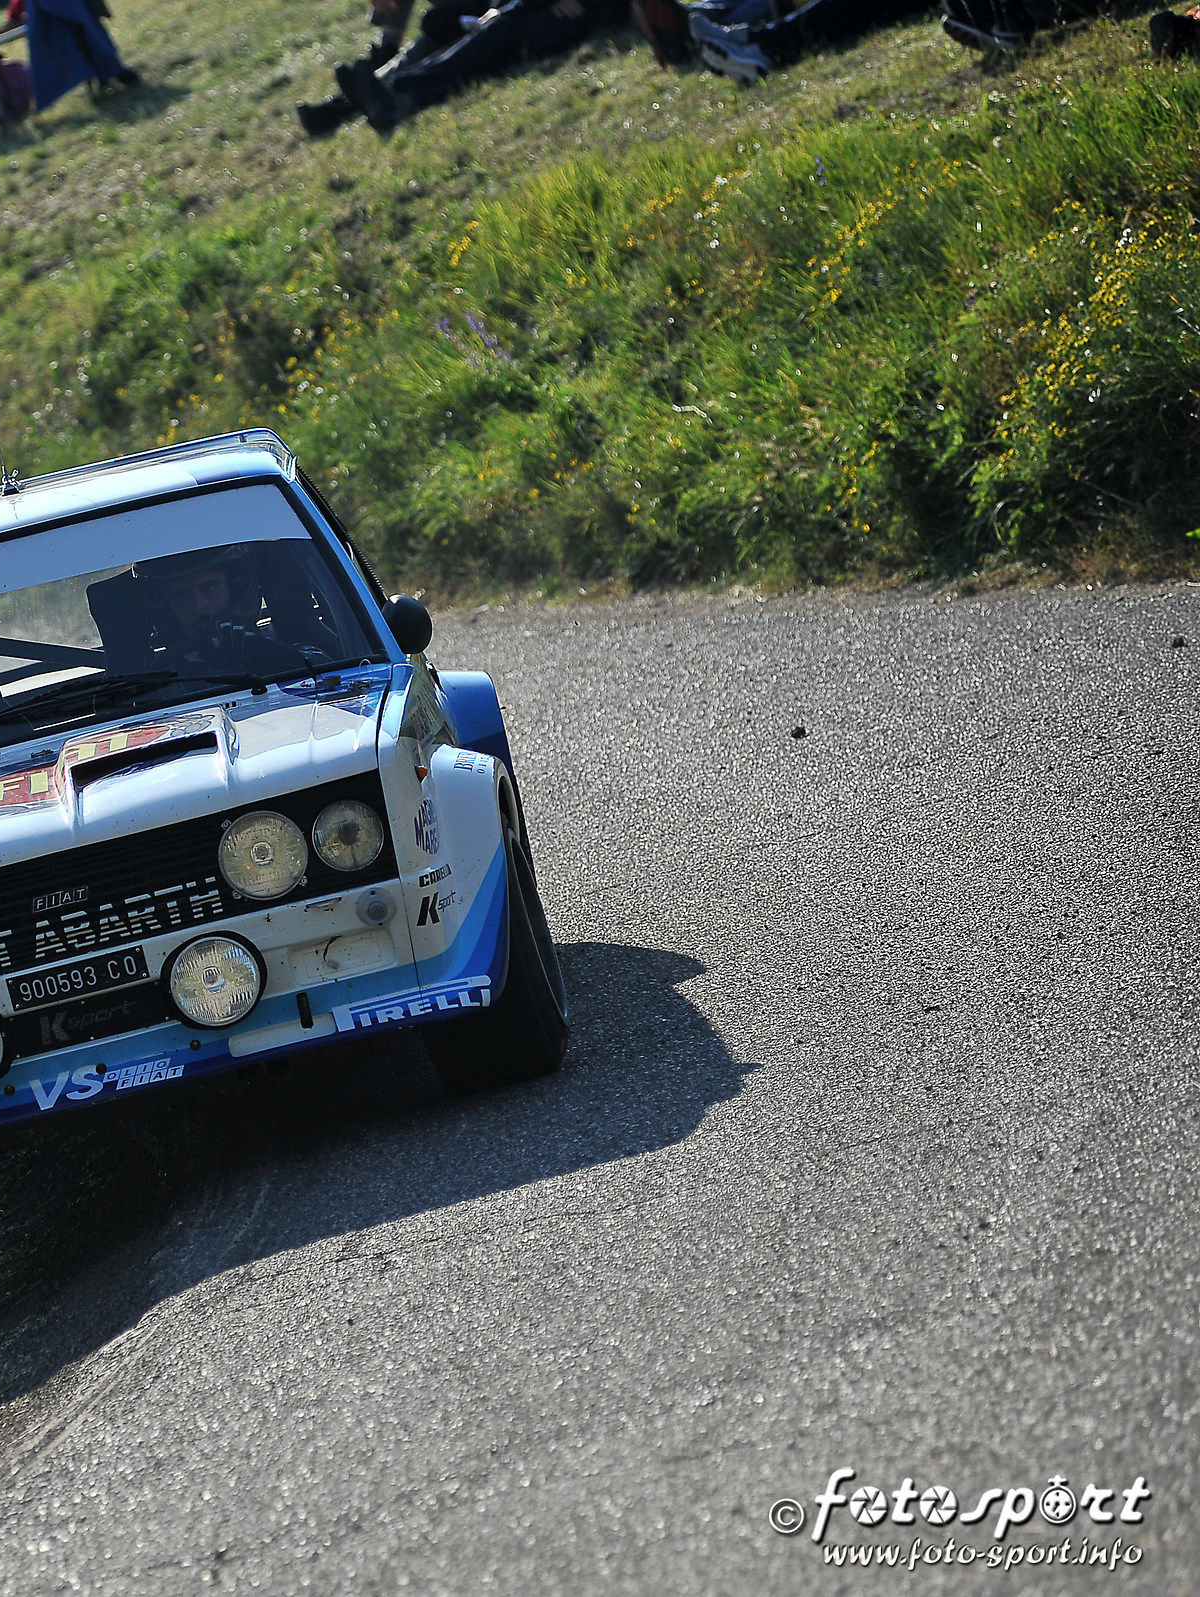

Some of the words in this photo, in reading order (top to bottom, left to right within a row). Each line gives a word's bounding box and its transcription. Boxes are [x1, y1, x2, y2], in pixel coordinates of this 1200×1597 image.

[34, 876, 224, 959] ABARTH
[35, 887, 86, 910] FIAT
[19, 965, 98, 1002] 900593
[107, 955, 138, 980] CO
[333, 975, 491, 1033] PIRELLI
[29, 1063, 104, 1111] VS
[105, 1060, 168, 1081] OLIO
[119, 1067, 180, 1088] FIAT
